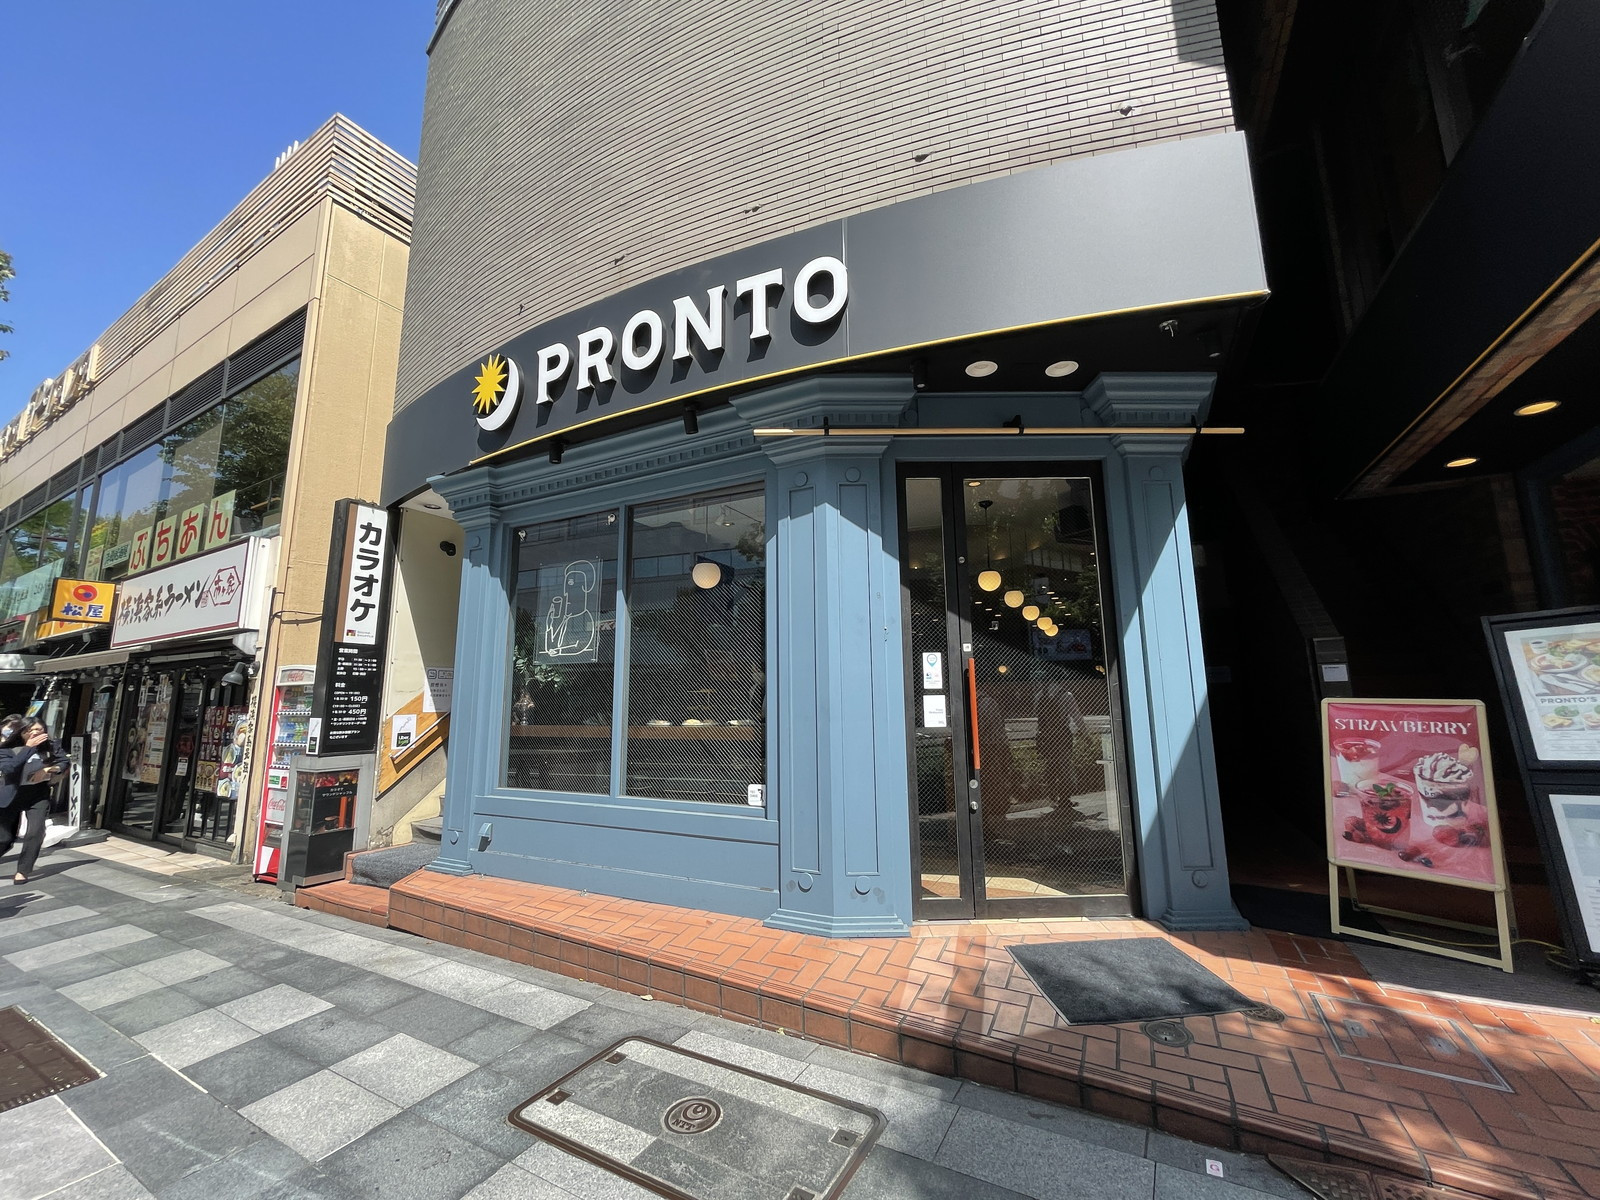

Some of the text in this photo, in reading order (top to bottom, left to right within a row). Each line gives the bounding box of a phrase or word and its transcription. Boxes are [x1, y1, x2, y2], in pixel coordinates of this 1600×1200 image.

[536, 256, 848, 405] PRONTO
[131, 500, 229, 570] ぷちあん
[350, 521, 383, 622] カラオケ
[60, 602, 104, 618] 松屋
[1540, 696, 1598, 704] PRONTO'S
[1334, 718, 1472, 735] STRAWBERRY
[671, 1118, 696, 1131] NTT
